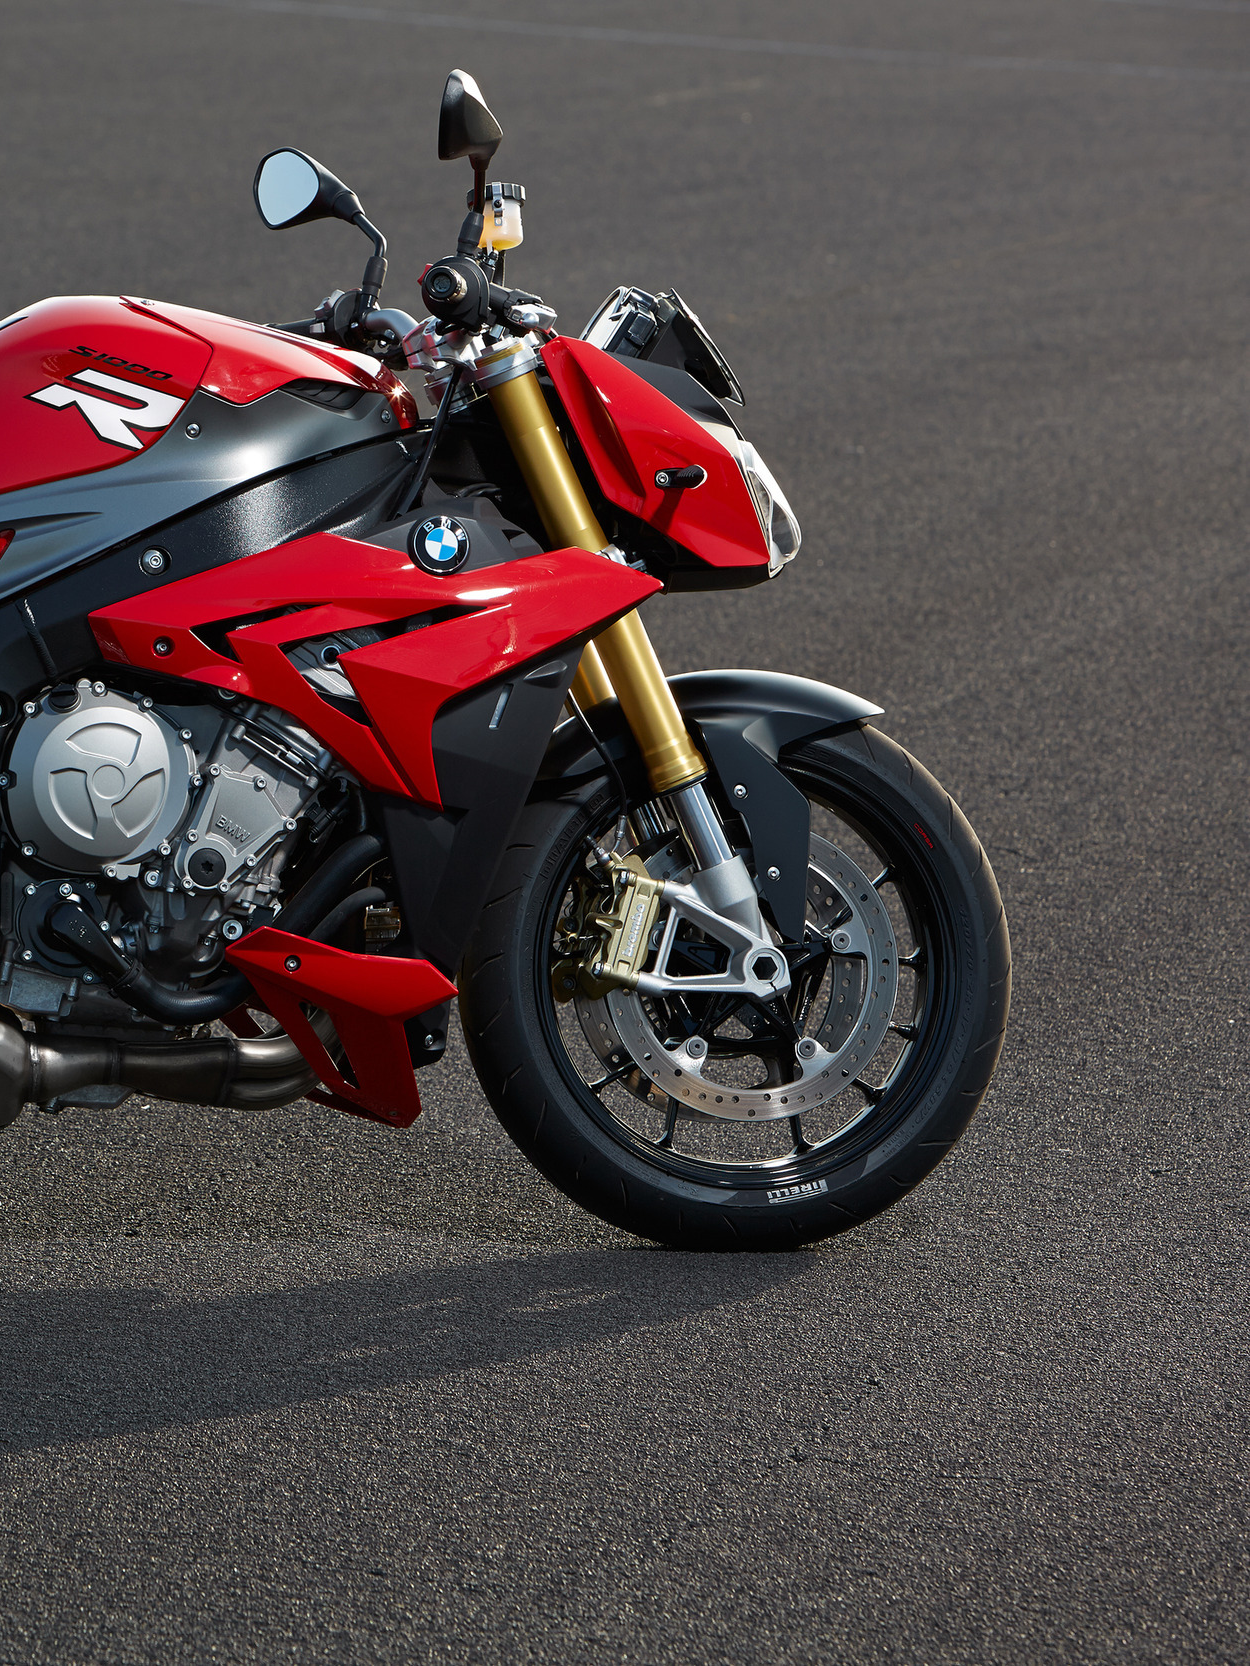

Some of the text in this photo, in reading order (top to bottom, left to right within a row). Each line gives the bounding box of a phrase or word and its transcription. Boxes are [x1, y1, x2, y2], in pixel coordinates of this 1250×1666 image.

[68, 345, 173, 381] S1000
[22, 366, 186, 452] R
[215, 814, 250, 842] BMW
[913, 822, 934, 849] CORSA
[621, 903, 646, 957] brembo
[767, 1179, 828, 1203] PIRELLI
